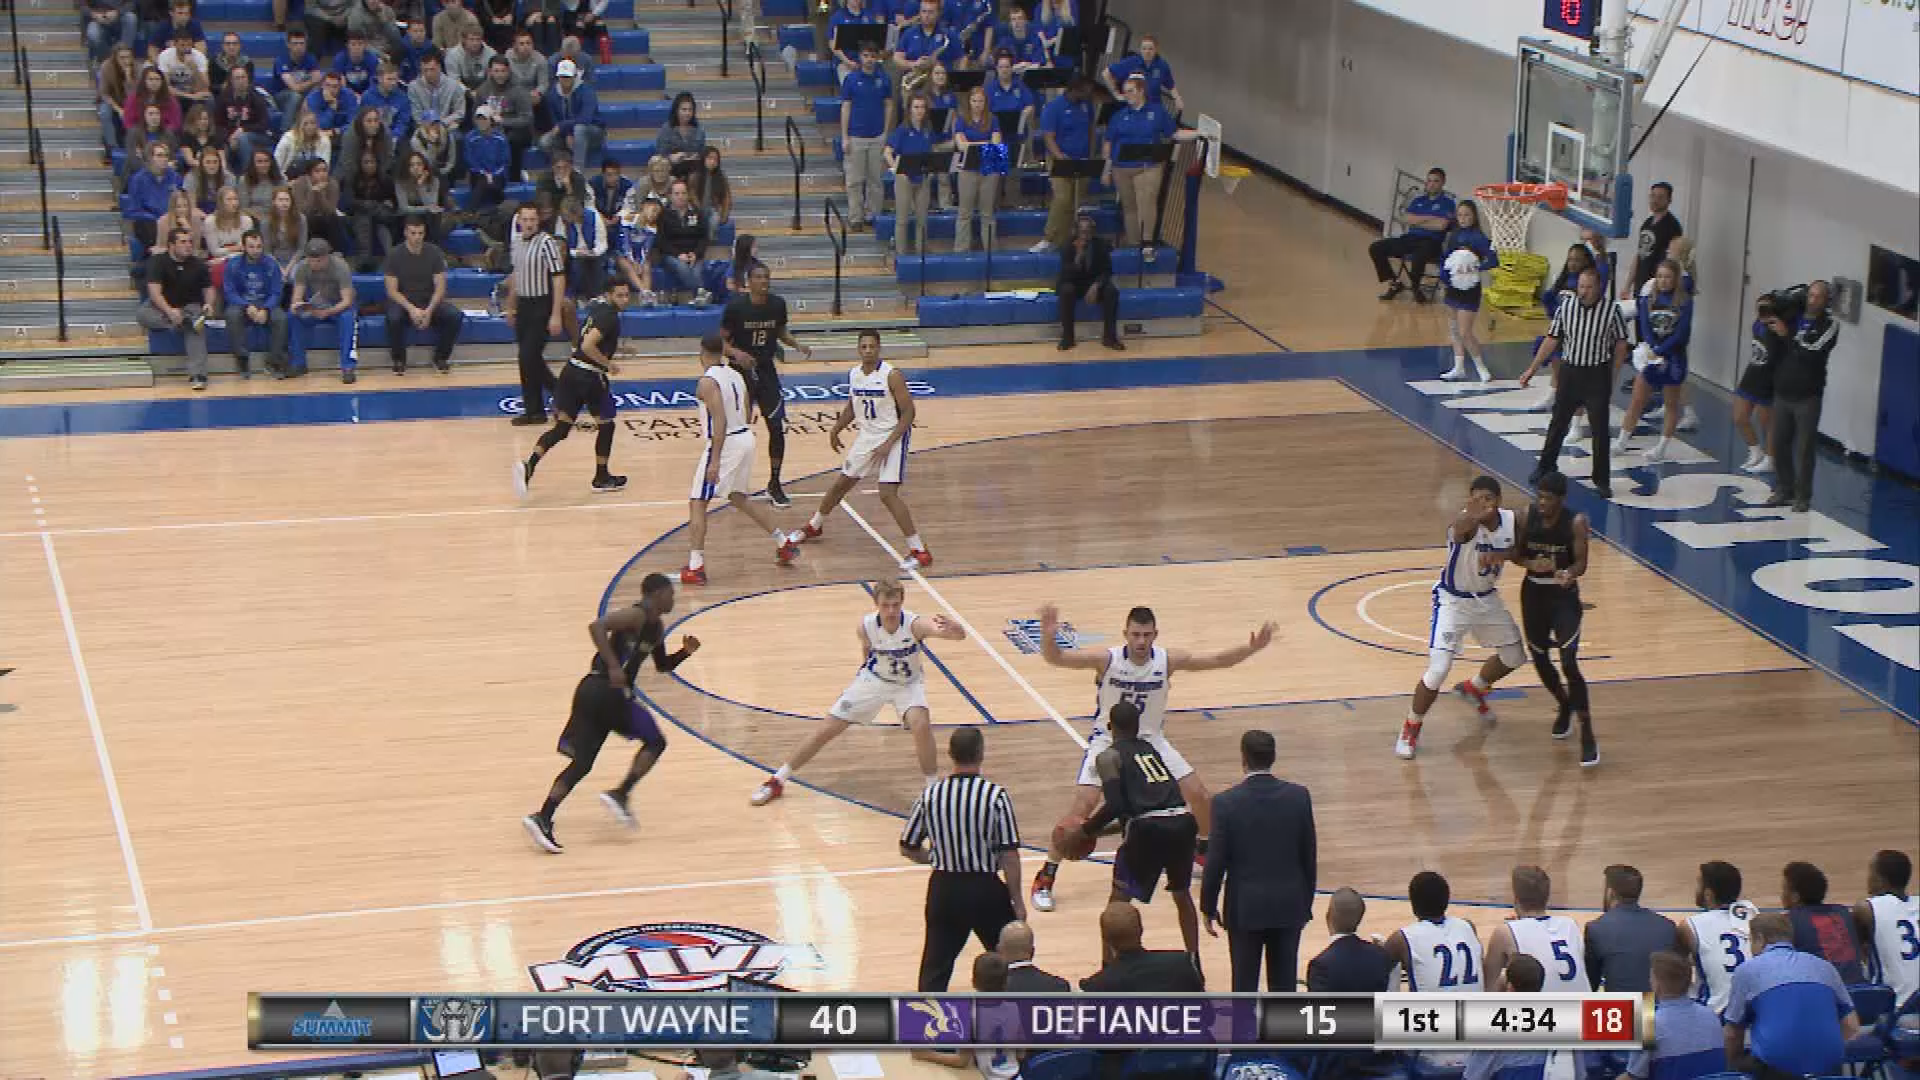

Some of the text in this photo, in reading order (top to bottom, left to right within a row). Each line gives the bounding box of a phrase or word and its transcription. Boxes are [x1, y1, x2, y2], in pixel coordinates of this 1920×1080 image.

[752, 330, 767, 346] 12
[731, 382, 740, 411] 1
[1134, 753, 1170, 783] 10
[1434, 941, 1479, 987] 22
[1550, 939, 1577, 981] 5
